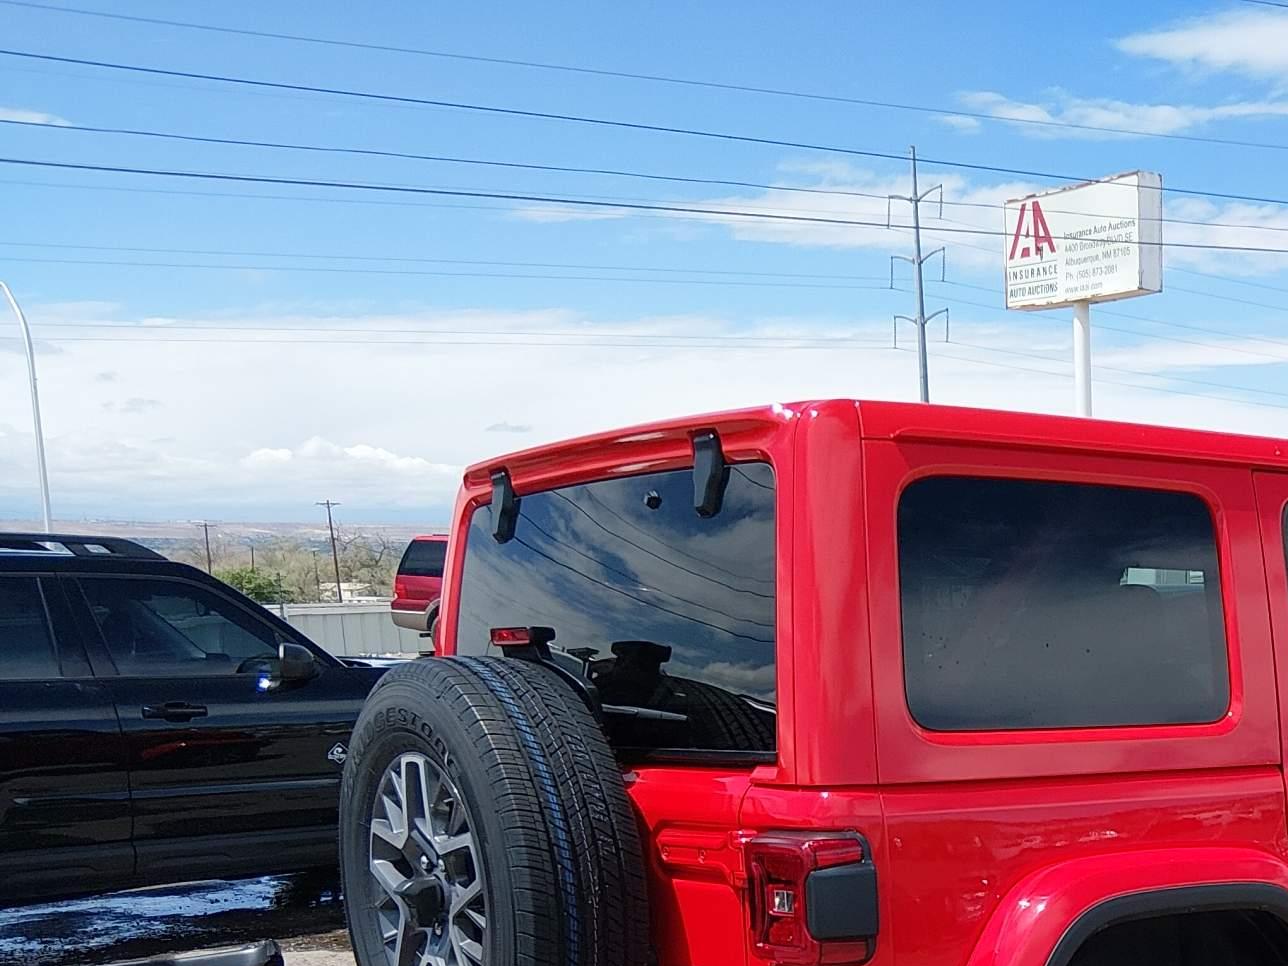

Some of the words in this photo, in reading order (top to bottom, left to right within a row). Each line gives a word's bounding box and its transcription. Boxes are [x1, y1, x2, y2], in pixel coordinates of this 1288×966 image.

[1064, 229, 1092, 240] Insurance
[1093, 225, 1107, 235] Auto
[1108, 219, 1136, 232] Auctions
[1102, 250, 1112, 260] NM
[1008, 264, 1058, 281] INSURANCE
[1009, 287, 1027, 299] AUTO
[1027, 282, 1058, 296] AUCTIONS
